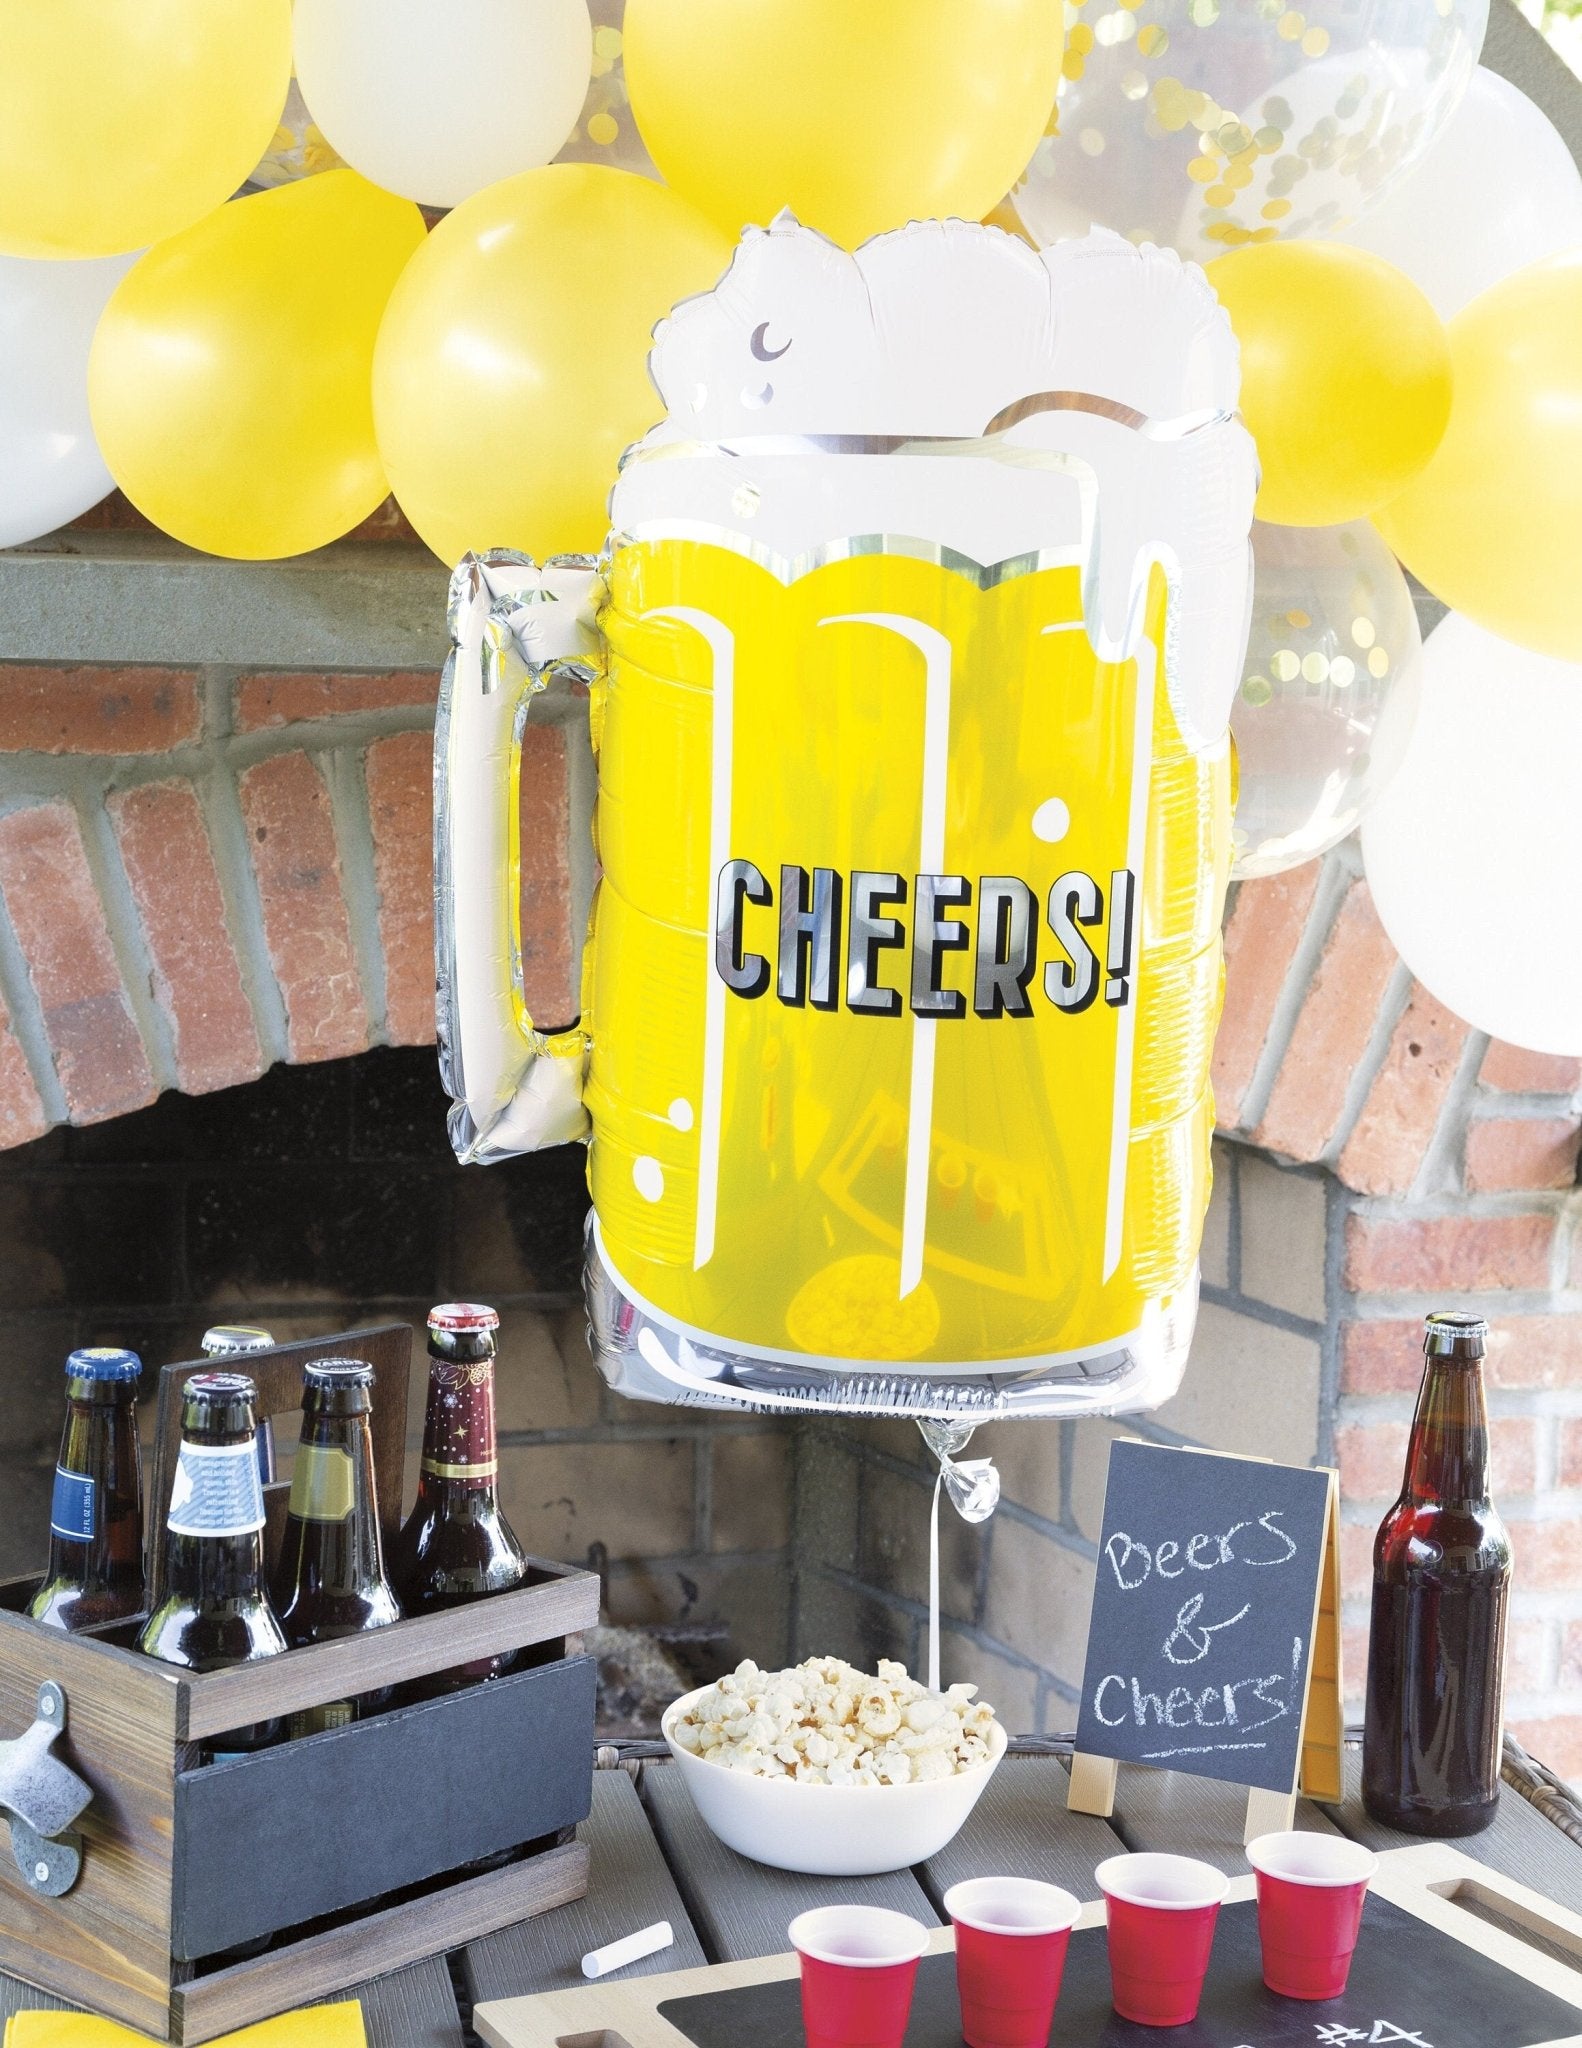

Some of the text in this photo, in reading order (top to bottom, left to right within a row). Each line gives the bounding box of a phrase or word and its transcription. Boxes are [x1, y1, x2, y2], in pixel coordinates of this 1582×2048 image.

[715, 858, 1136, 1019] CHEERS!
[84, 1510, 91, 1518] OZ
[1104, 1511, 1297, 1589] Beers
[1162, 1593, 1251, 1664] &
[1094, 1637, 1302, 1733] Cheers!
[1313, 2020, 1434, 2048] #4
